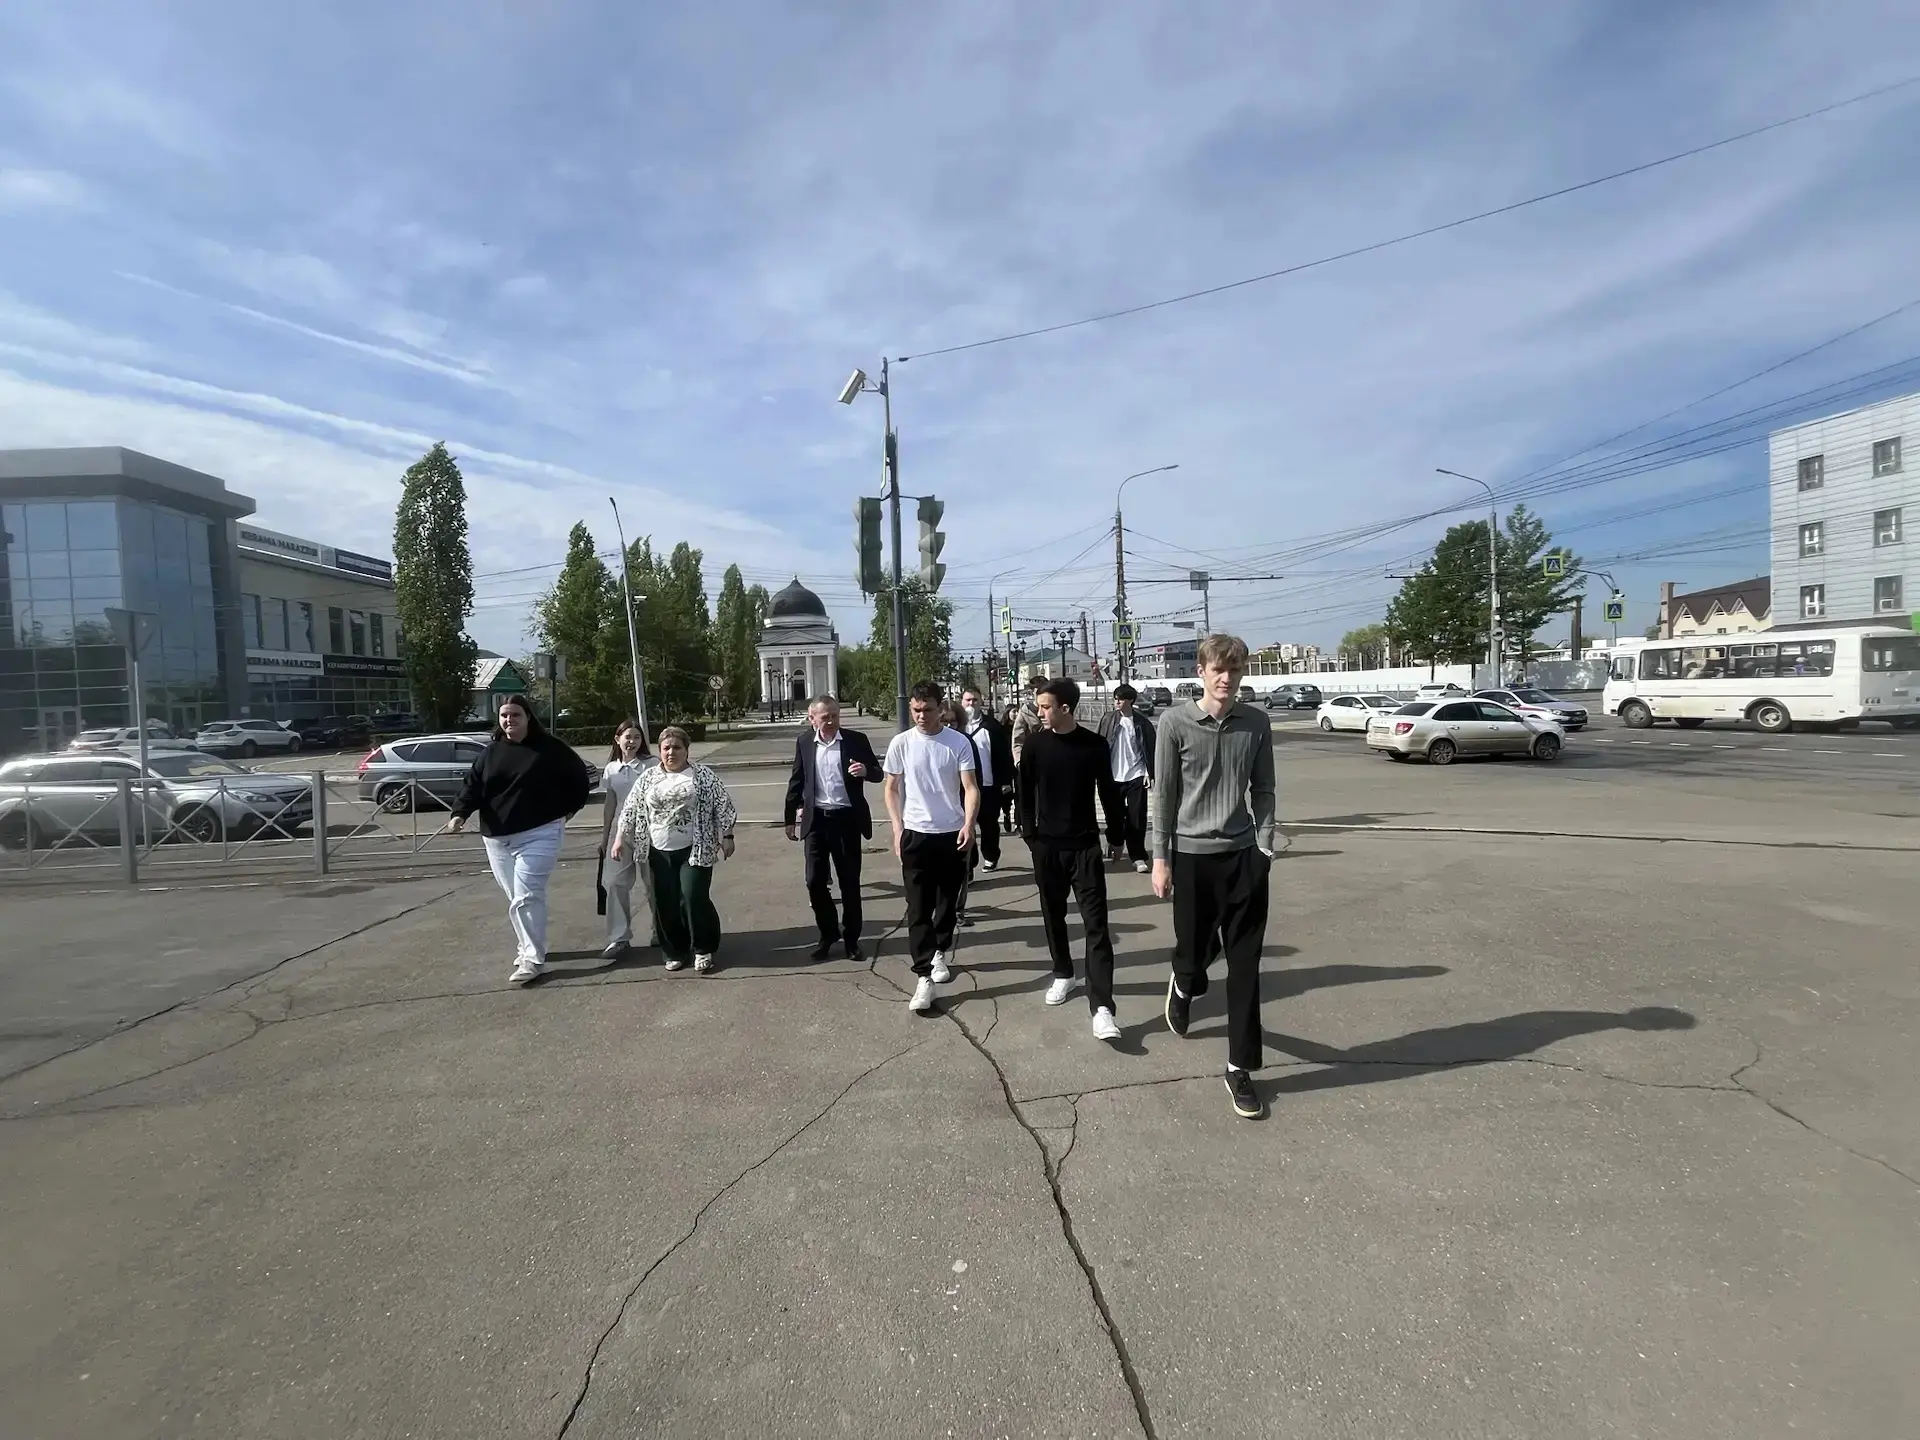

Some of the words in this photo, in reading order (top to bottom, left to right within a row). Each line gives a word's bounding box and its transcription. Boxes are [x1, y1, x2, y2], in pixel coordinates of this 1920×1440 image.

[241, 530, 277, 546] KERAMA
[277, 539, 319, 556] MARAZZI
[246, 656, 280, 667] KERAMA
[282, 658, 321, 669] MARAZZI
